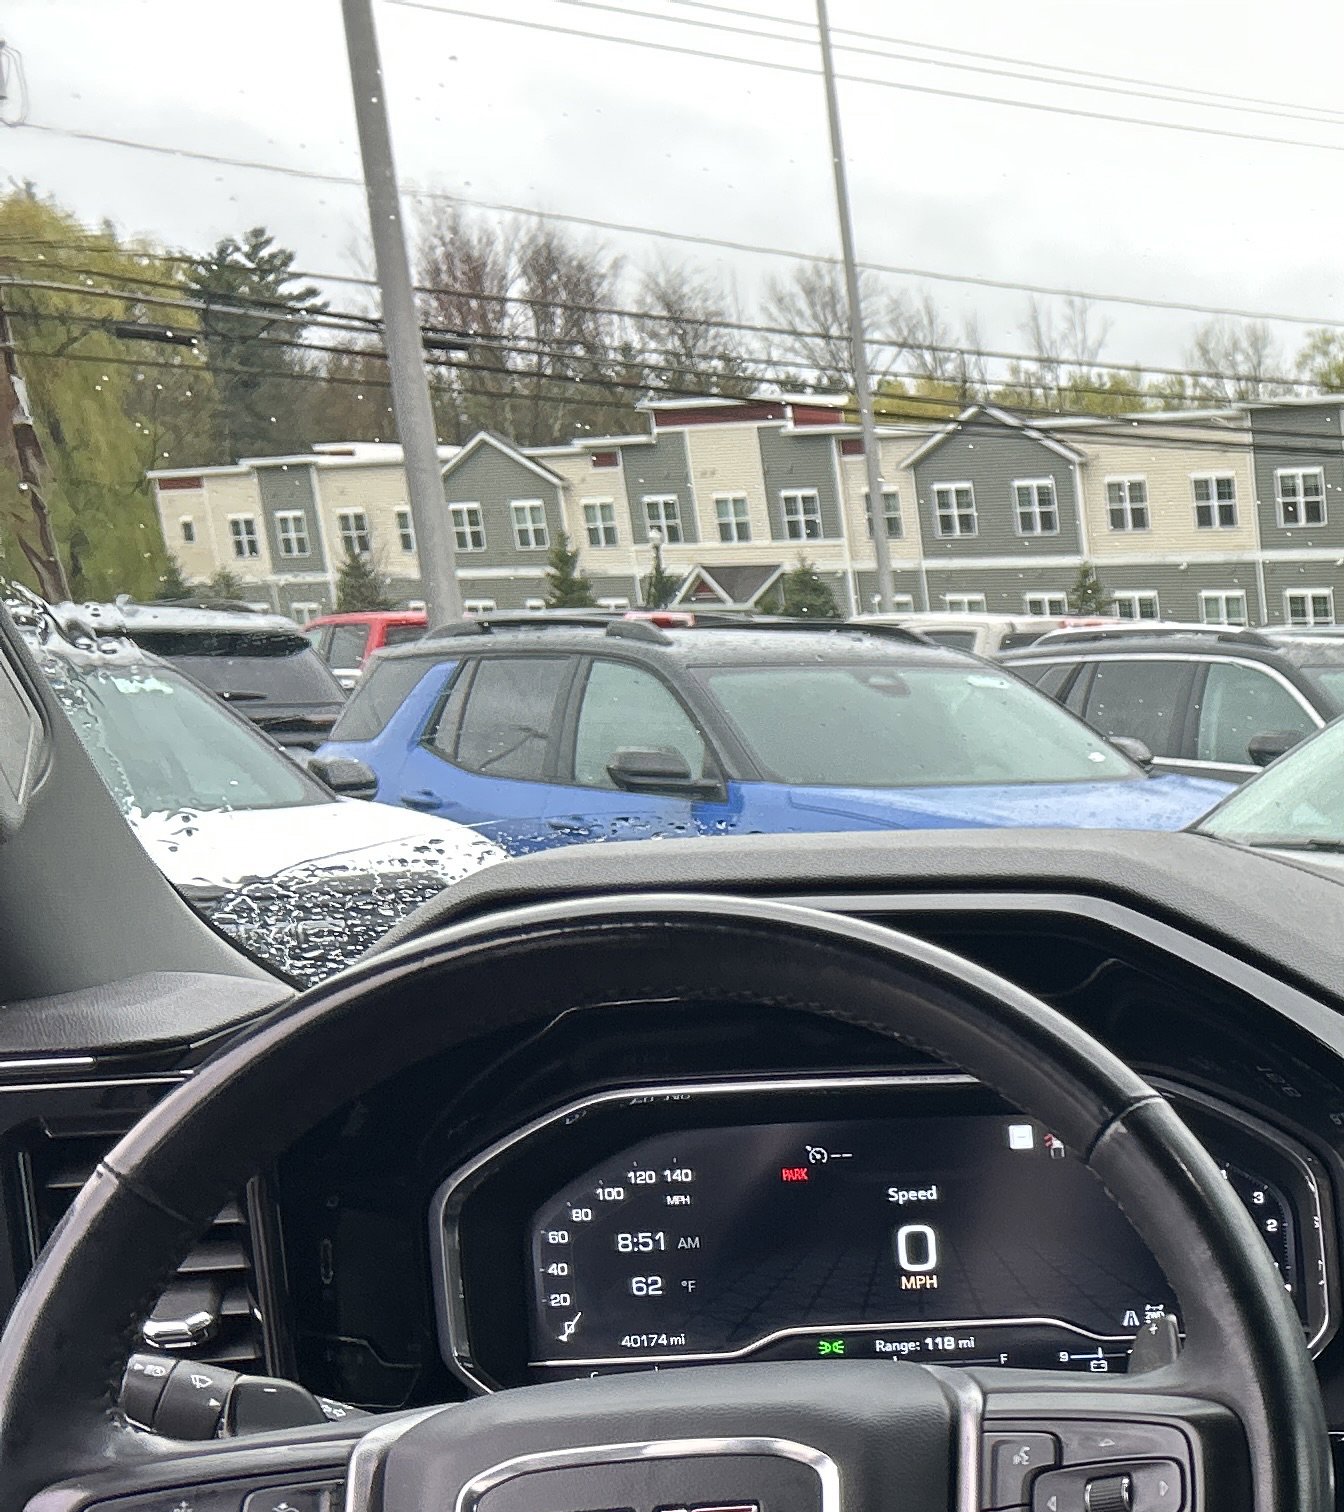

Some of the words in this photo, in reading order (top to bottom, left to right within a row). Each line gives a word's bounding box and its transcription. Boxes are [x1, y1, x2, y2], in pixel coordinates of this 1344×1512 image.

[627, 1170, 656, 1184] 120
[664, 1168, 692, 1182] 140
[781, 1168, 809, 1181] PARK
[596, 1187, 624, 1200] 100
[666, 1195, 691, 1206] MPH
[887, 1185, 938, 1205] Speed
[1252, 1191, 1264, 1204] 3
[572, 1208, 592, 1222] 80
[1265, 1218, 1278, 1232] 2
[548, 1231, 569, 1244] 60
[617, 1231, 666, 1252] 8:51
[677, 1236, 701, 1250] AM
[897, 1224, 937, 1272] 0
[548, 1263, 568, 1276] 40
[631, 1276, 664, 1296] 62
[901, 1275, 938, 1289] MPH
[550, 1294, 571, 1307] 20
[621, 1333, 667, 1348] 40174
[669, 1333, 686, 1346] mi
[875, 1339, 921, 1354] Range:
[924, 1336, 956, 1351] 118
[958, 1336, 975, 1349] mi
